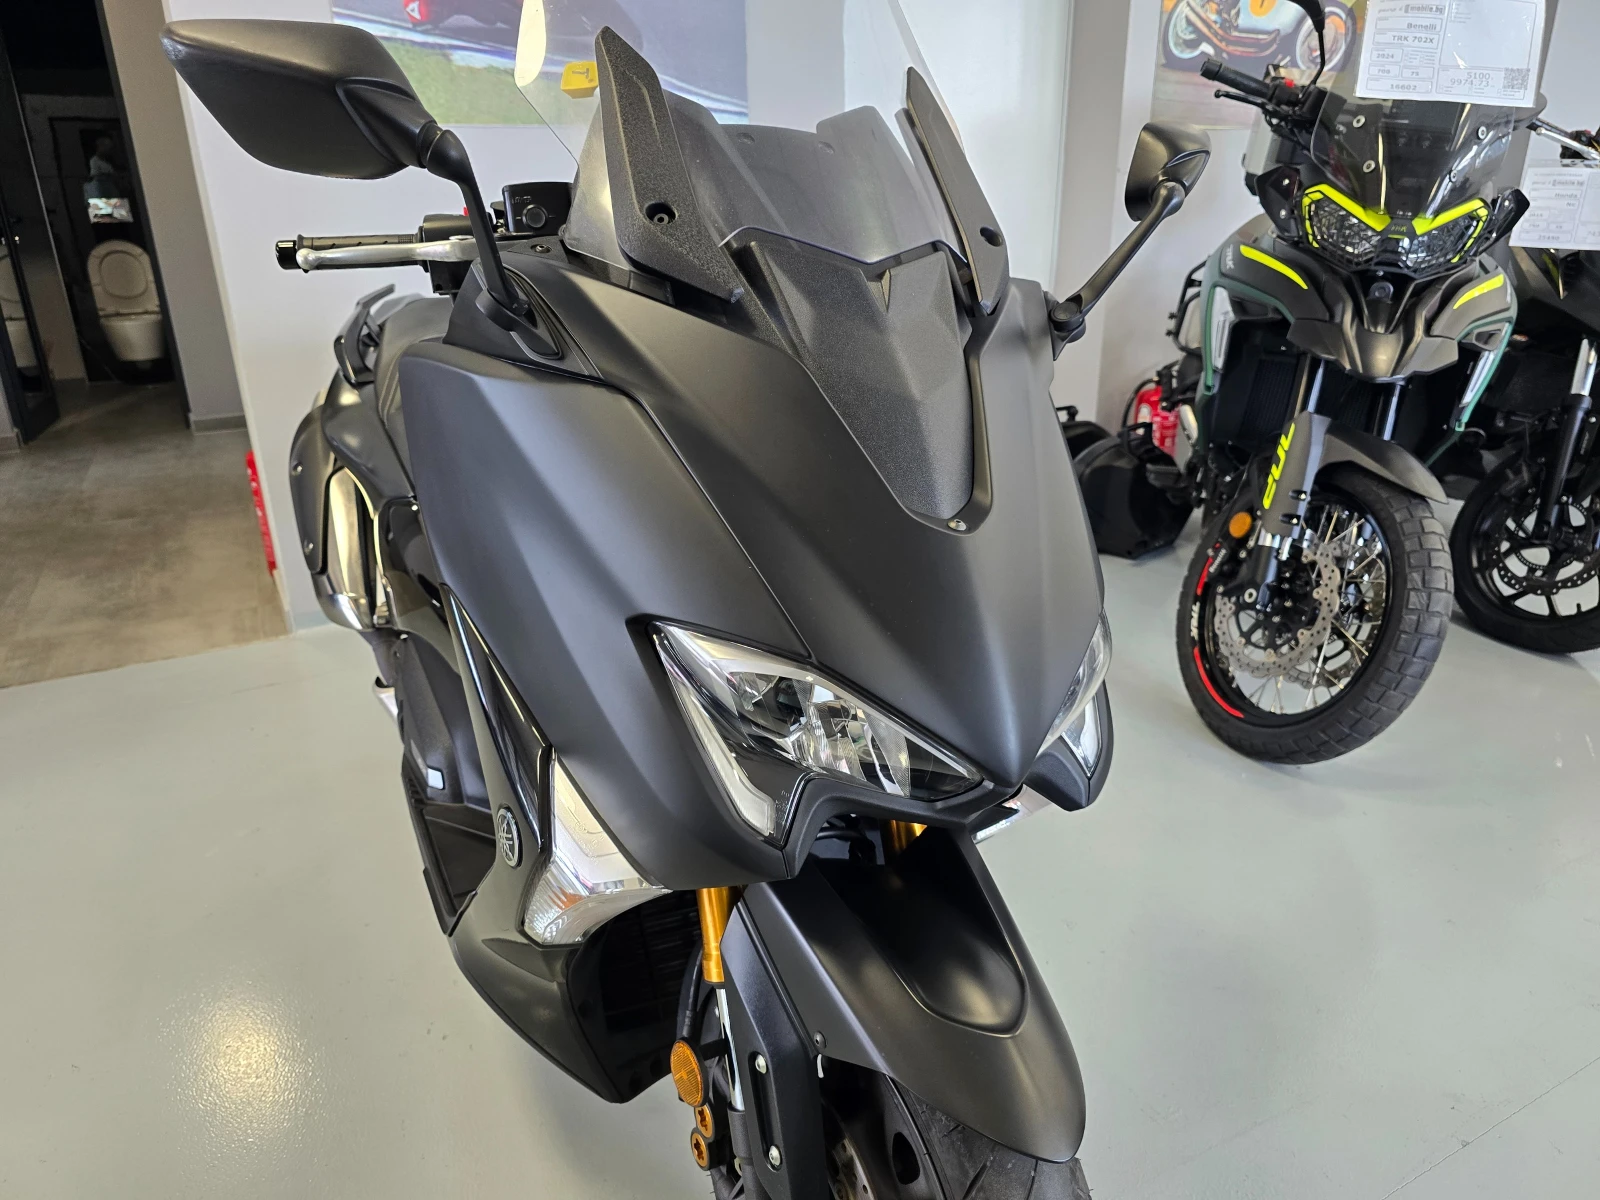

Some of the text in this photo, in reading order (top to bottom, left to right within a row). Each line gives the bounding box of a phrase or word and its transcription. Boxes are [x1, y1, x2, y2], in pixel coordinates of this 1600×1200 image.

[1407, 22, 1437, 31] Benelli
[1412, 36, 1435, 44] 702X
[1390, 83, 1417, 91] 16602
